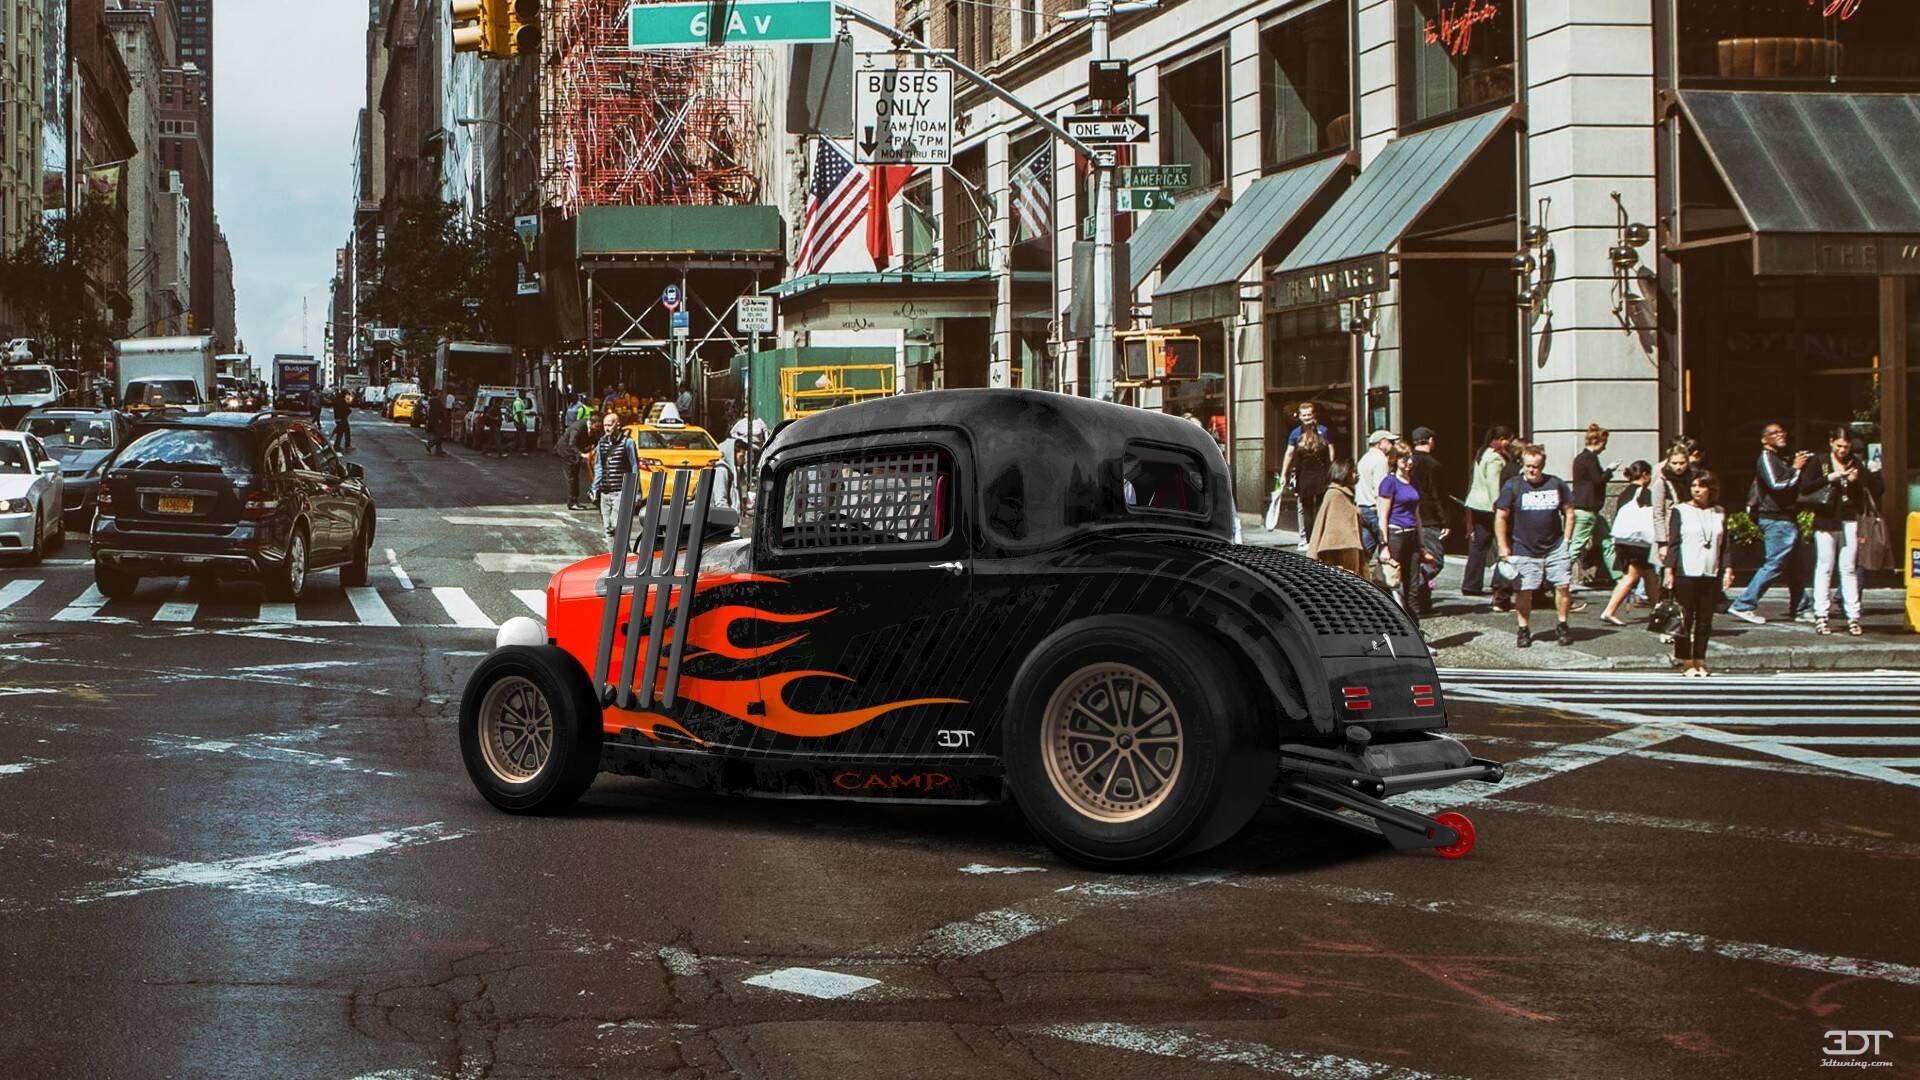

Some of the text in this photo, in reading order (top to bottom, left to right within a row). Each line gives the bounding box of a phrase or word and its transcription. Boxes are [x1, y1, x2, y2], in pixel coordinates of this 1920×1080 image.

[690, 10, 772, 37] 6 Av
[869, 76, 938, 93] BUSES
[876, 99, 930, 116] ONLY
[1075, 124, 1137, 136] ONE WAY
[881, 149, 946, 159] MON THRU FRI
[1132, 173, 1188, 186] AMERICAS
[1143, 191, 1153, 208] 6
